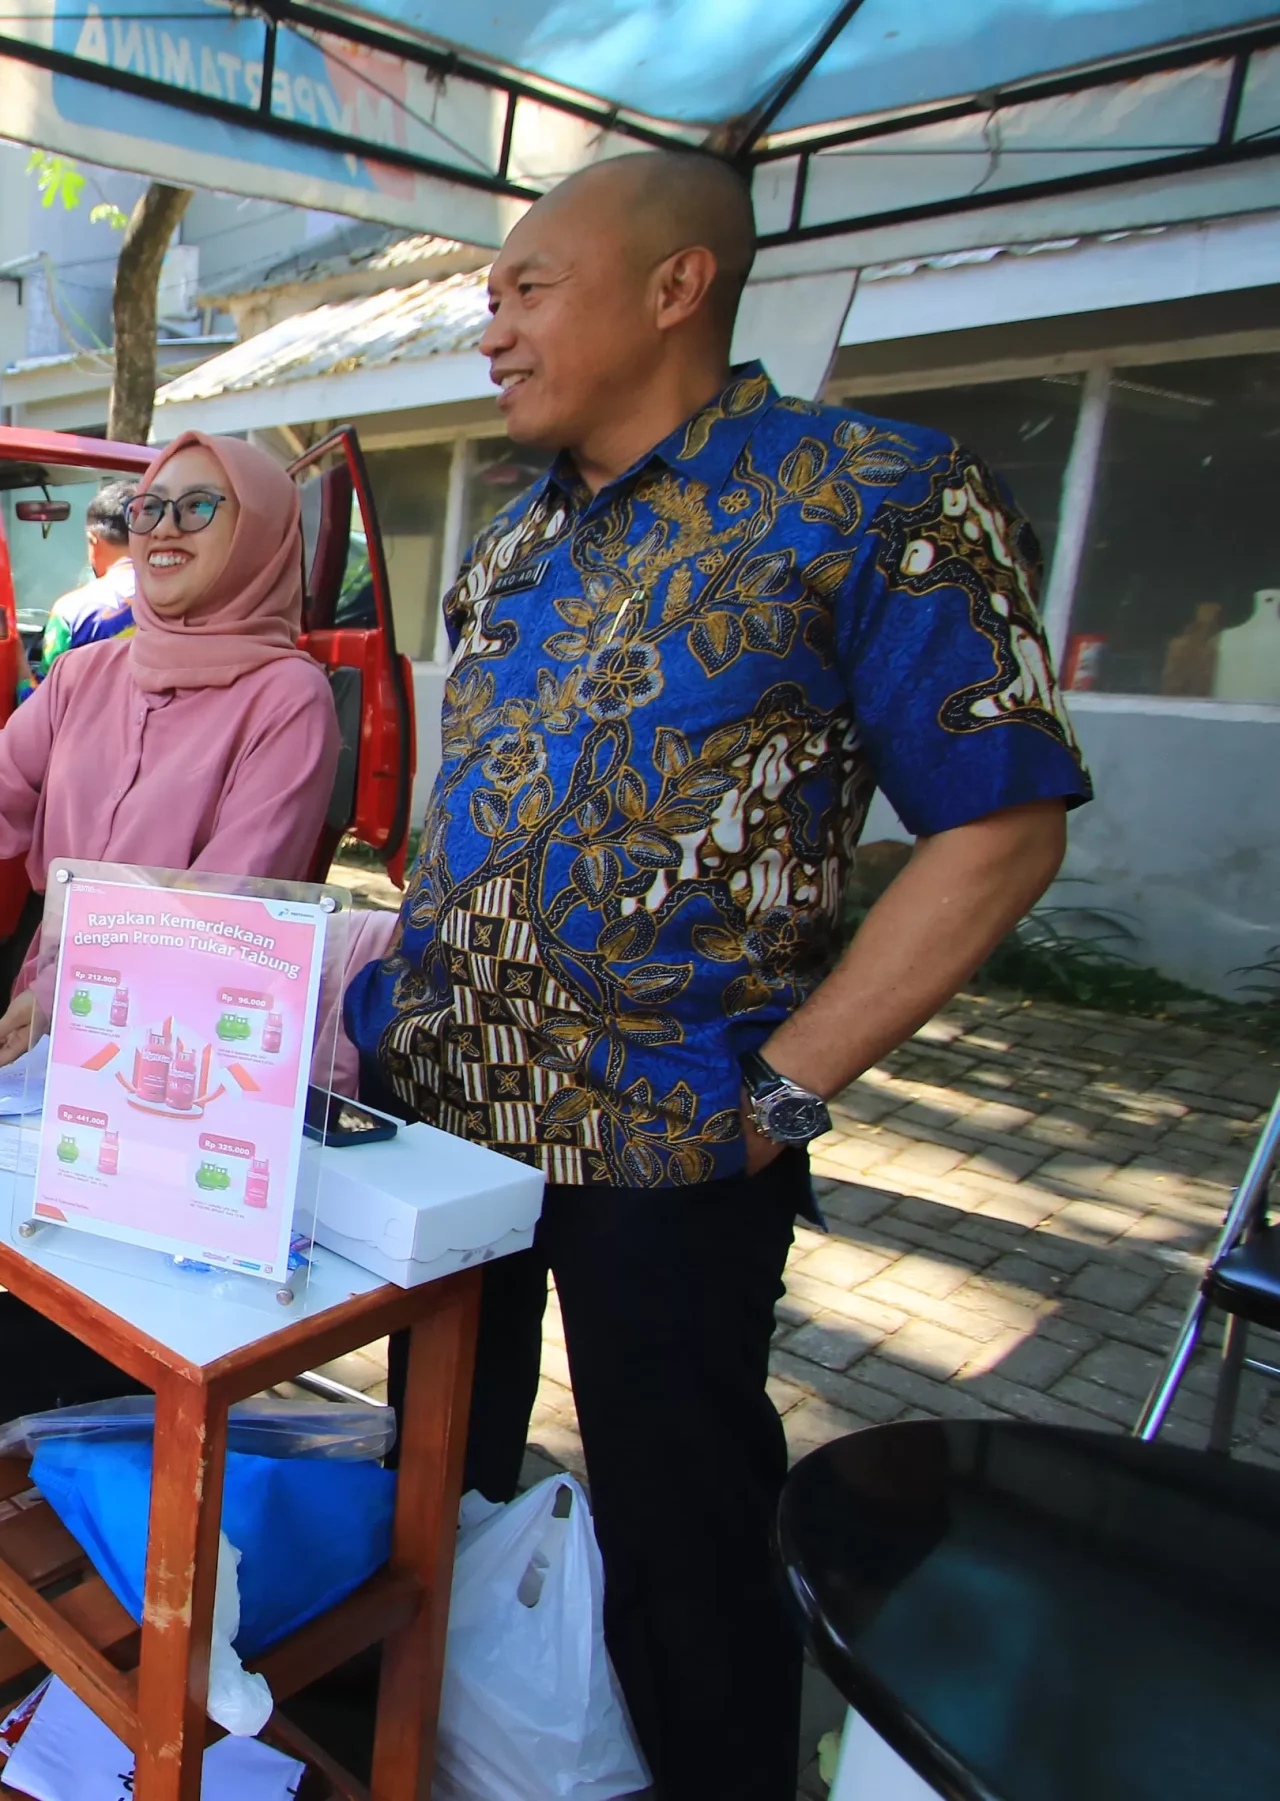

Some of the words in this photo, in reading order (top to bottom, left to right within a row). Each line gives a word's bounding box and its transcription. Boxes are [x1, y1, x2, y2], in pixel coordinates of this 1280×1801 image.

[88, 911, 155, 930] Rayakan
[160, 912, 276, 951] Kemerdekaan
[74, 931, 129, 948] dengan
[133, 930, 184, 949] Promo
[189, 935, 236, 958] Tukar
[239, 946, 301, 980] Tabung
[75, 970, 86, 980] Rp
[221, 993, 233, 1003] Rp
[238, 996, 267, 1007] 96.000
[63, 1110, 73, 1120] Rp
[76, 1113, 106, 1126] 441.000
[204, 1139, 217, 1150] Rp
[218, 1142, 251, 1156] 325.000
